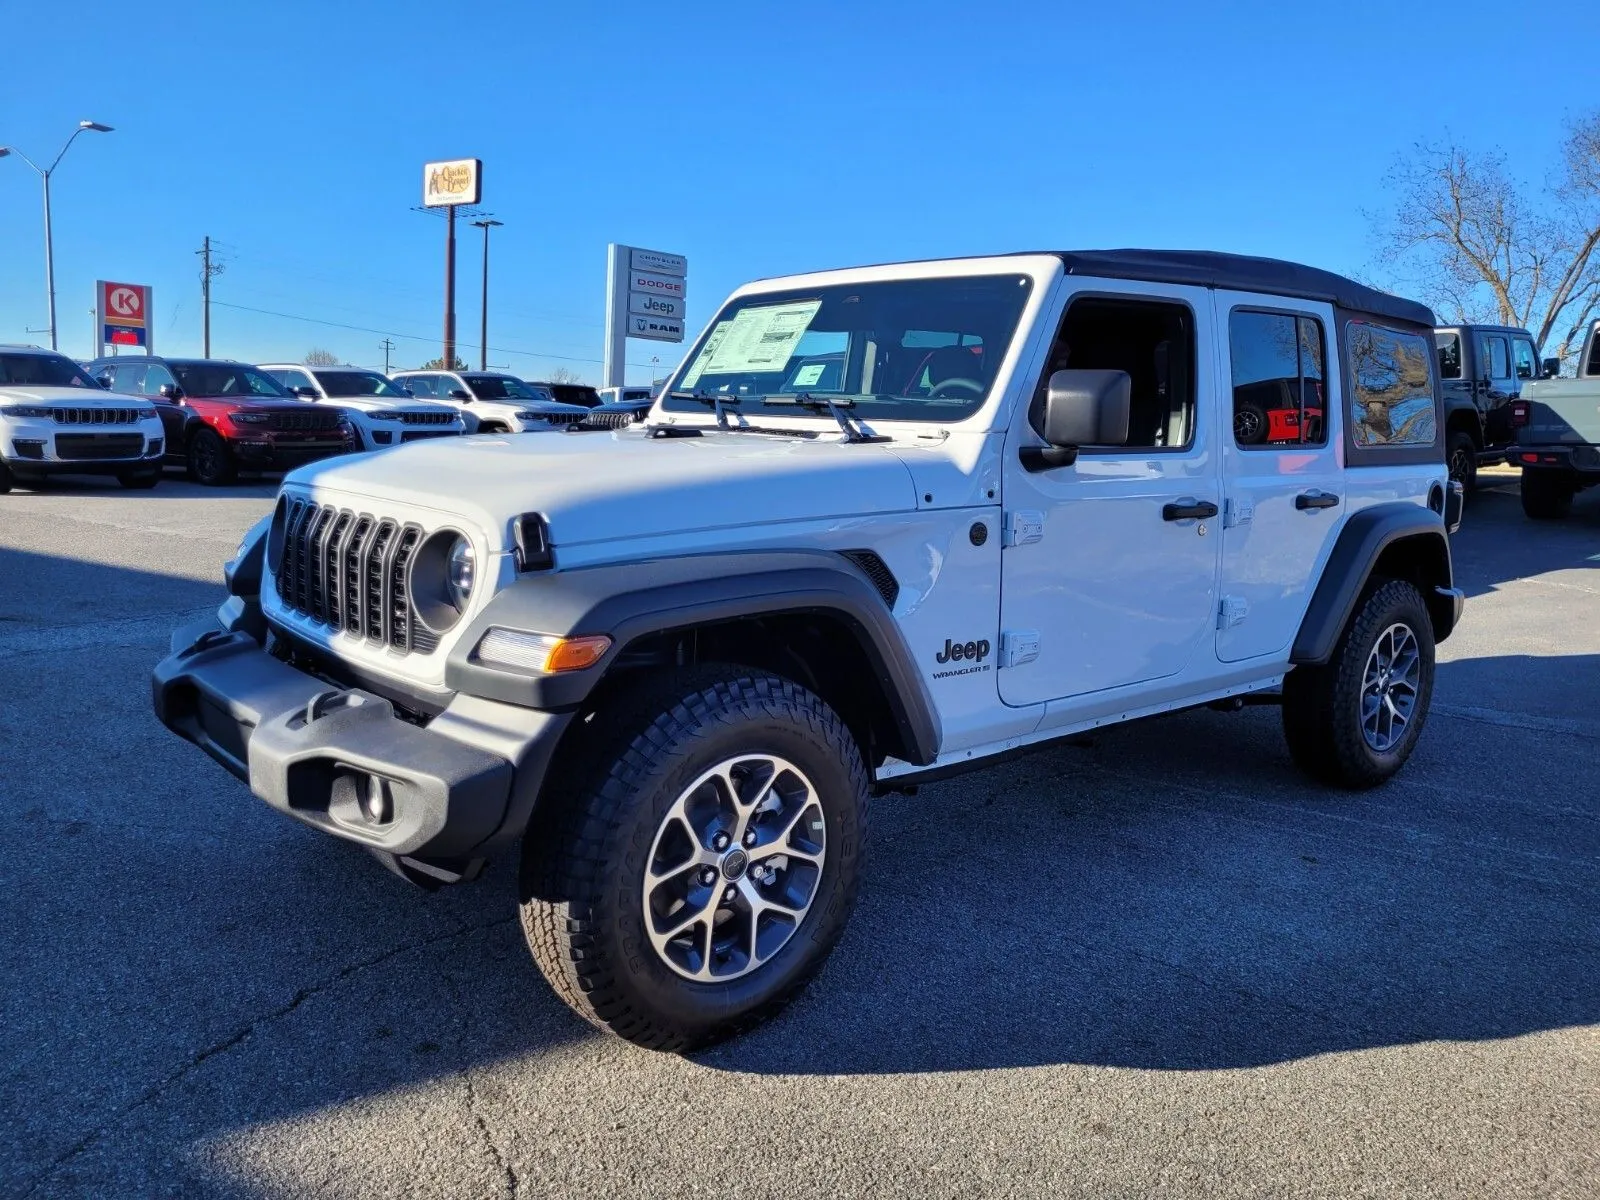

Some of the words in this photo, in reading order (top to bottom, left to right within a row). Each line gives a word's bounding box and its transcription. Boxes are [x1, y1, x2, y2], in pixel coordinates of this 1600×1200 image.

[640, 255, 681, 265] CHRYSLER
[637, 279, 682, 291] DODGE
[119, 293, 137, 313] K
[643, 297, 675, 315] Jeep
[649, 323, 680, 333] RAM
[936, 639, 990, 664] Jeep
[932, 666, 981, 679] WRANGLER
